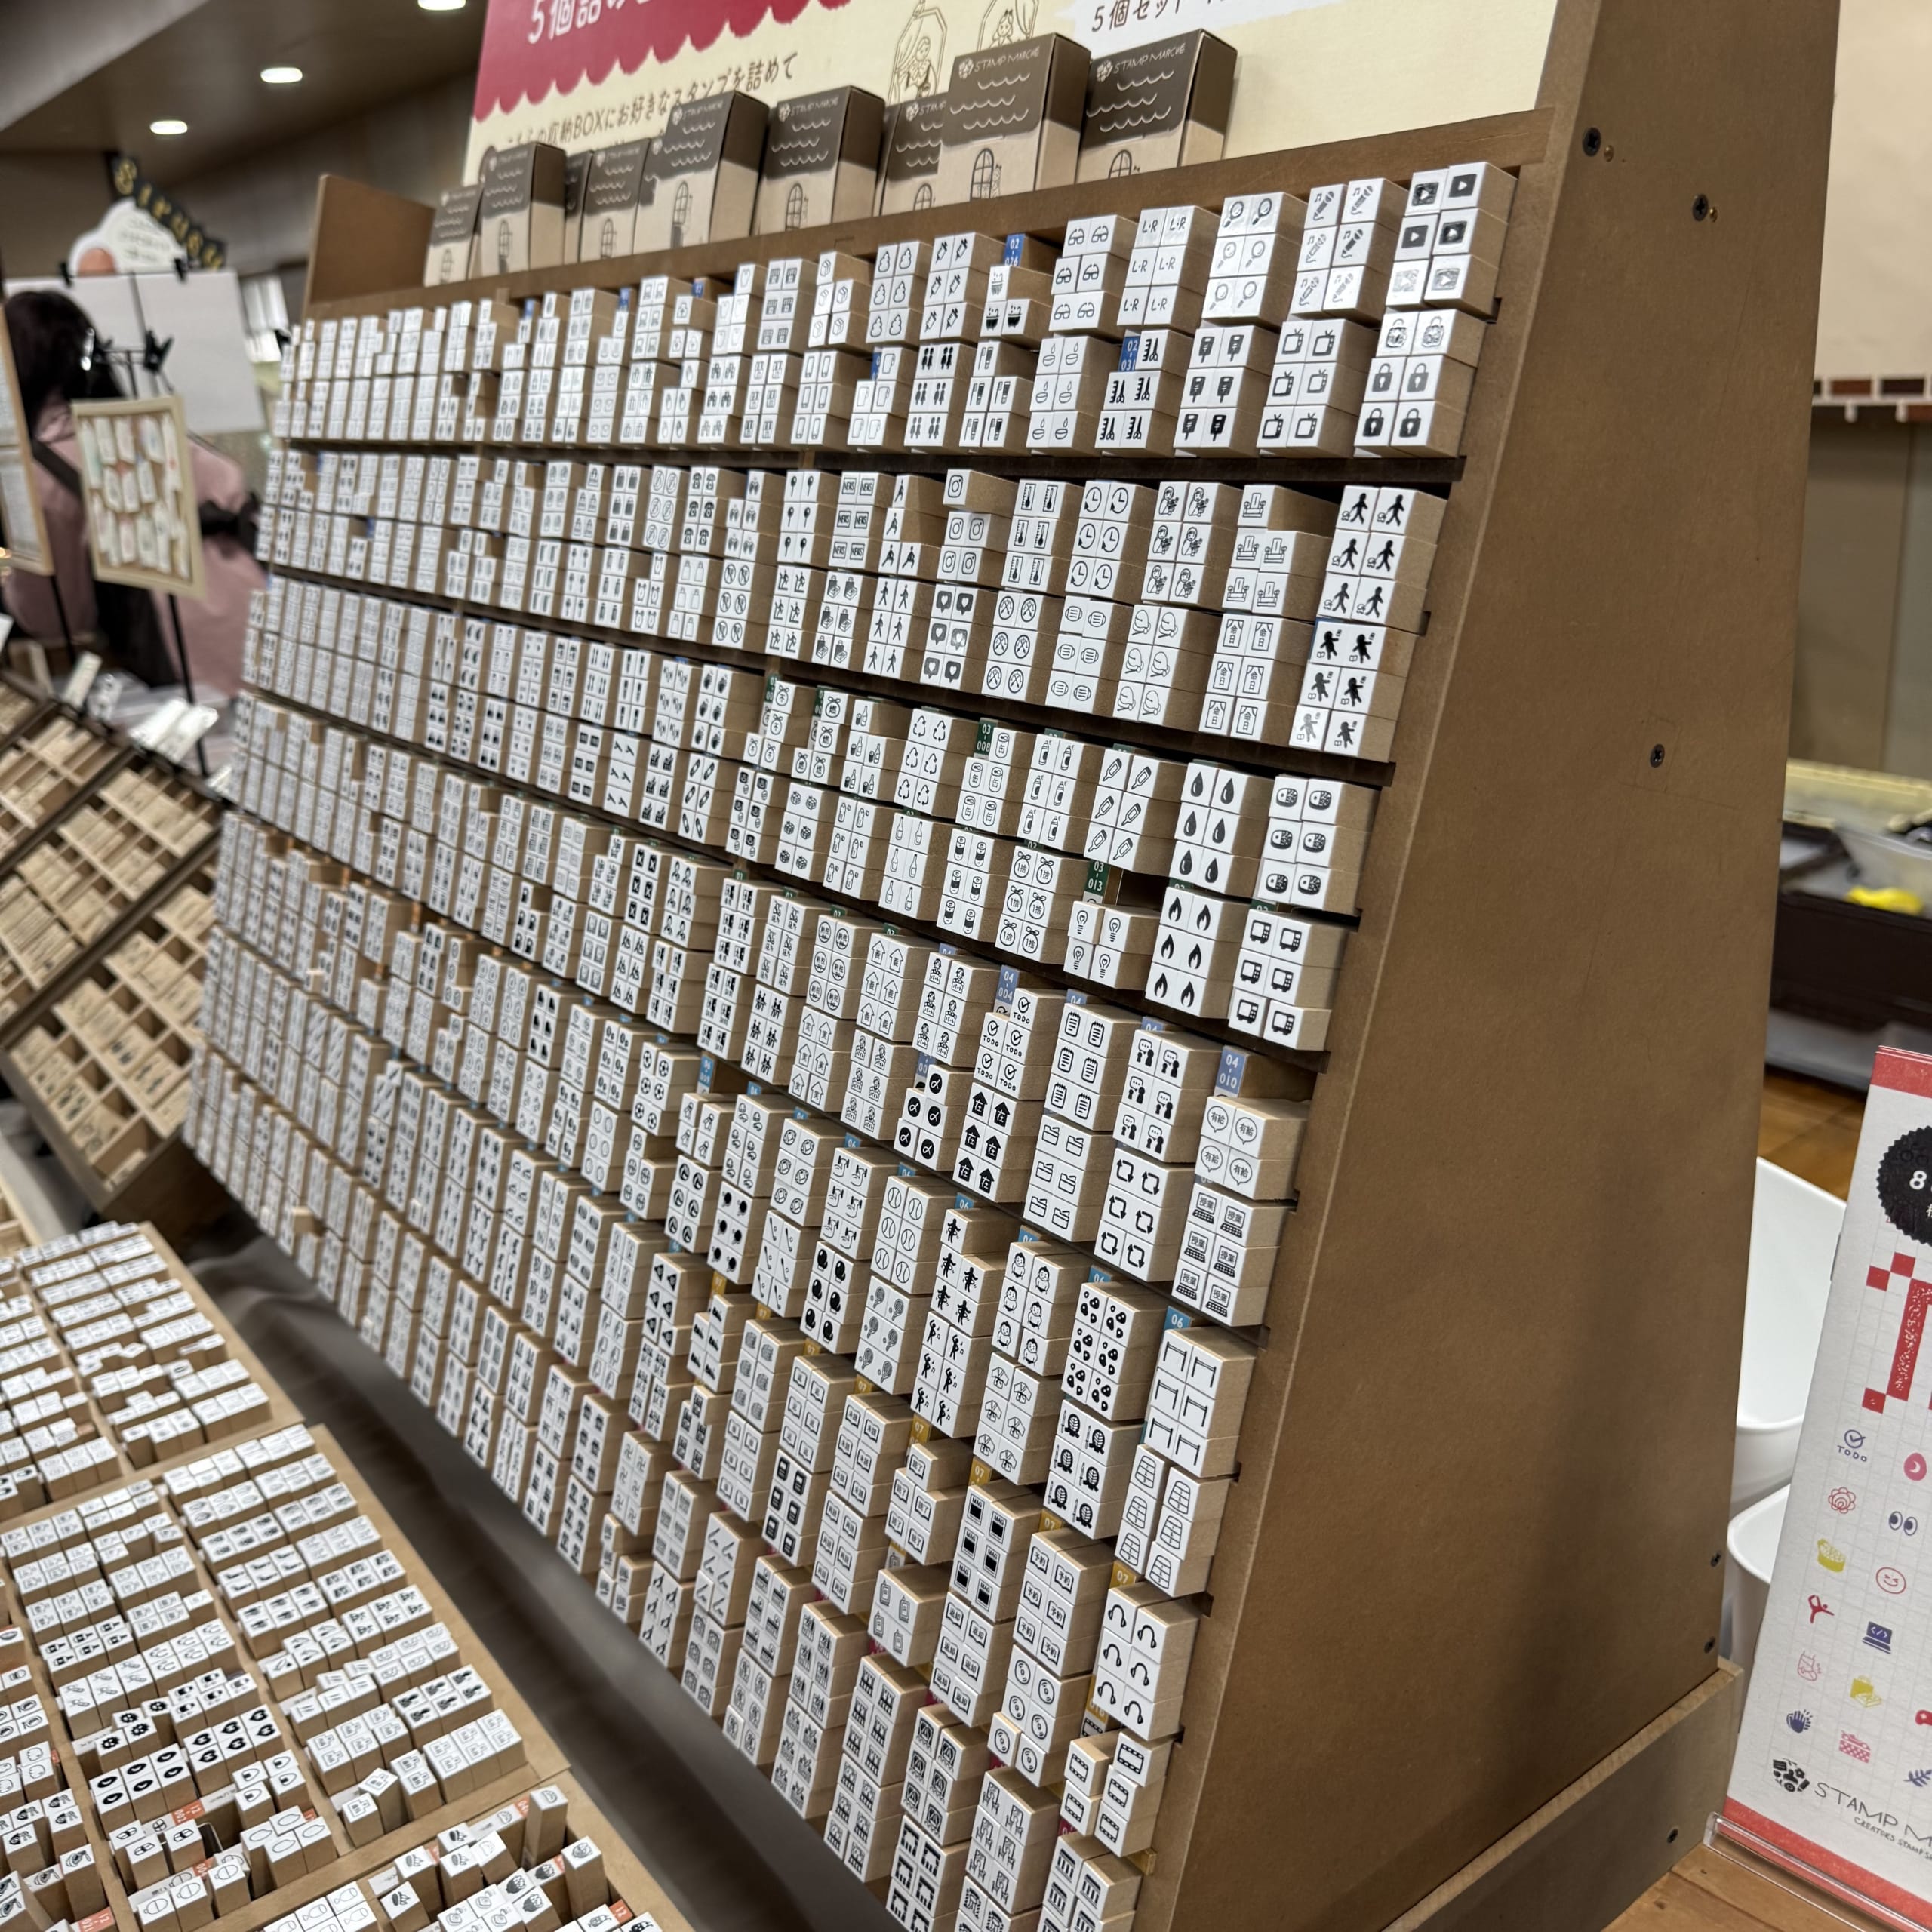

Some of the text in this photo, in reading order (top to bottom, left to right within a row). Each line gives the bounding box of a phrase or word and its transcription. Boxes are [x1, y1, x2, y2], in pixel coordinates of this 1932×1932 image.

[974, 56, 1006, 72] STAMP
[1114, 56, 1149, 74] STAMP
[1010, 240, 1019, 248] 02
[1127, 341, 1138, 351] 02
[982, 724, 991, 734] 03
[977, 740, 990, 752] 008
[1094, 862, 1104, 872] 03
[1088, 878, 1103, 891] 013
[1004, 971, 1014, 983] 04
[998, 989, 1013, 1001] 004
[1014, 1012, 1030, 1024] TODO
[983, 1035, 999, 1047] TODO
[1006, 1044, 1022, 1057] TODO
[1226, 1054, 1238, 1066] 04
[977, 1068, 993, 1080] TODO
[1000, 1078, 1016, 1091] TODO
[1220, 1075, 1238, 1088] 010
[974, 1101, 983, 1113] 在
[997, 1111, 1006, 1123] 在
[1210, 1111, 1226, 1126] 有給
[1238, 1122, 1254, 1137] 有給
[967, 1134, 976, 1146] 在
[988, 1145, 997, 1156] 在
[1204, 1150, 1220, 1165] 有給
[960, 1167, 970, 1177] 在
[1233, 1163, 1249, 1178] 有給
[981, 1178, 990, 1189] 在
[1199, 1196, 1214, 1211] 授業
[1227, 1210, 1242, 1225] 授業
[1191, 1235, 1205, 1249] 授業
[1220, 1251, 1235, 1263] 授業
[1183, 1273, 1197, 1286] 授業
[1213, 1289, 1227, 1303] 授業
[1171, 1314, 1183, 1327] 06
[915, 1422, 924, 1433] 07
[1837, 1444, 1868, 1463] TODO
[975, 1466, 984, 1478] 07
[972, 1497, 982, 1507] MAG
[994, 1515, 1004, 1525] MAG
[1044, 1518, 1055, 1531] 07
[966, 1531, 975, 1541] MAG
[988, 1549, 998, 1559] MAG
[1034, 1552, 1046, 1565] 予約
[959, 1564, 968, 1575] MAG
[1058, 1571, 1070, 1584] 予約
[1117, 1569, 1128, 1583] 07
[981, 1583, 990, 1592] MAG
[1027, 1587, 1038, 1600] 予約
[1051, 1607, 1063, 1620] 予約
[1021, 1623, 1032, 1635] 予約
[1044, 1642, 1057, 1657] 予約
[1814, 1782, 1898, 1827] STAMP
[1854, 1817, 1895, 1842] CREATORS
[1897, 1838, 1924, 1855] STAMP
